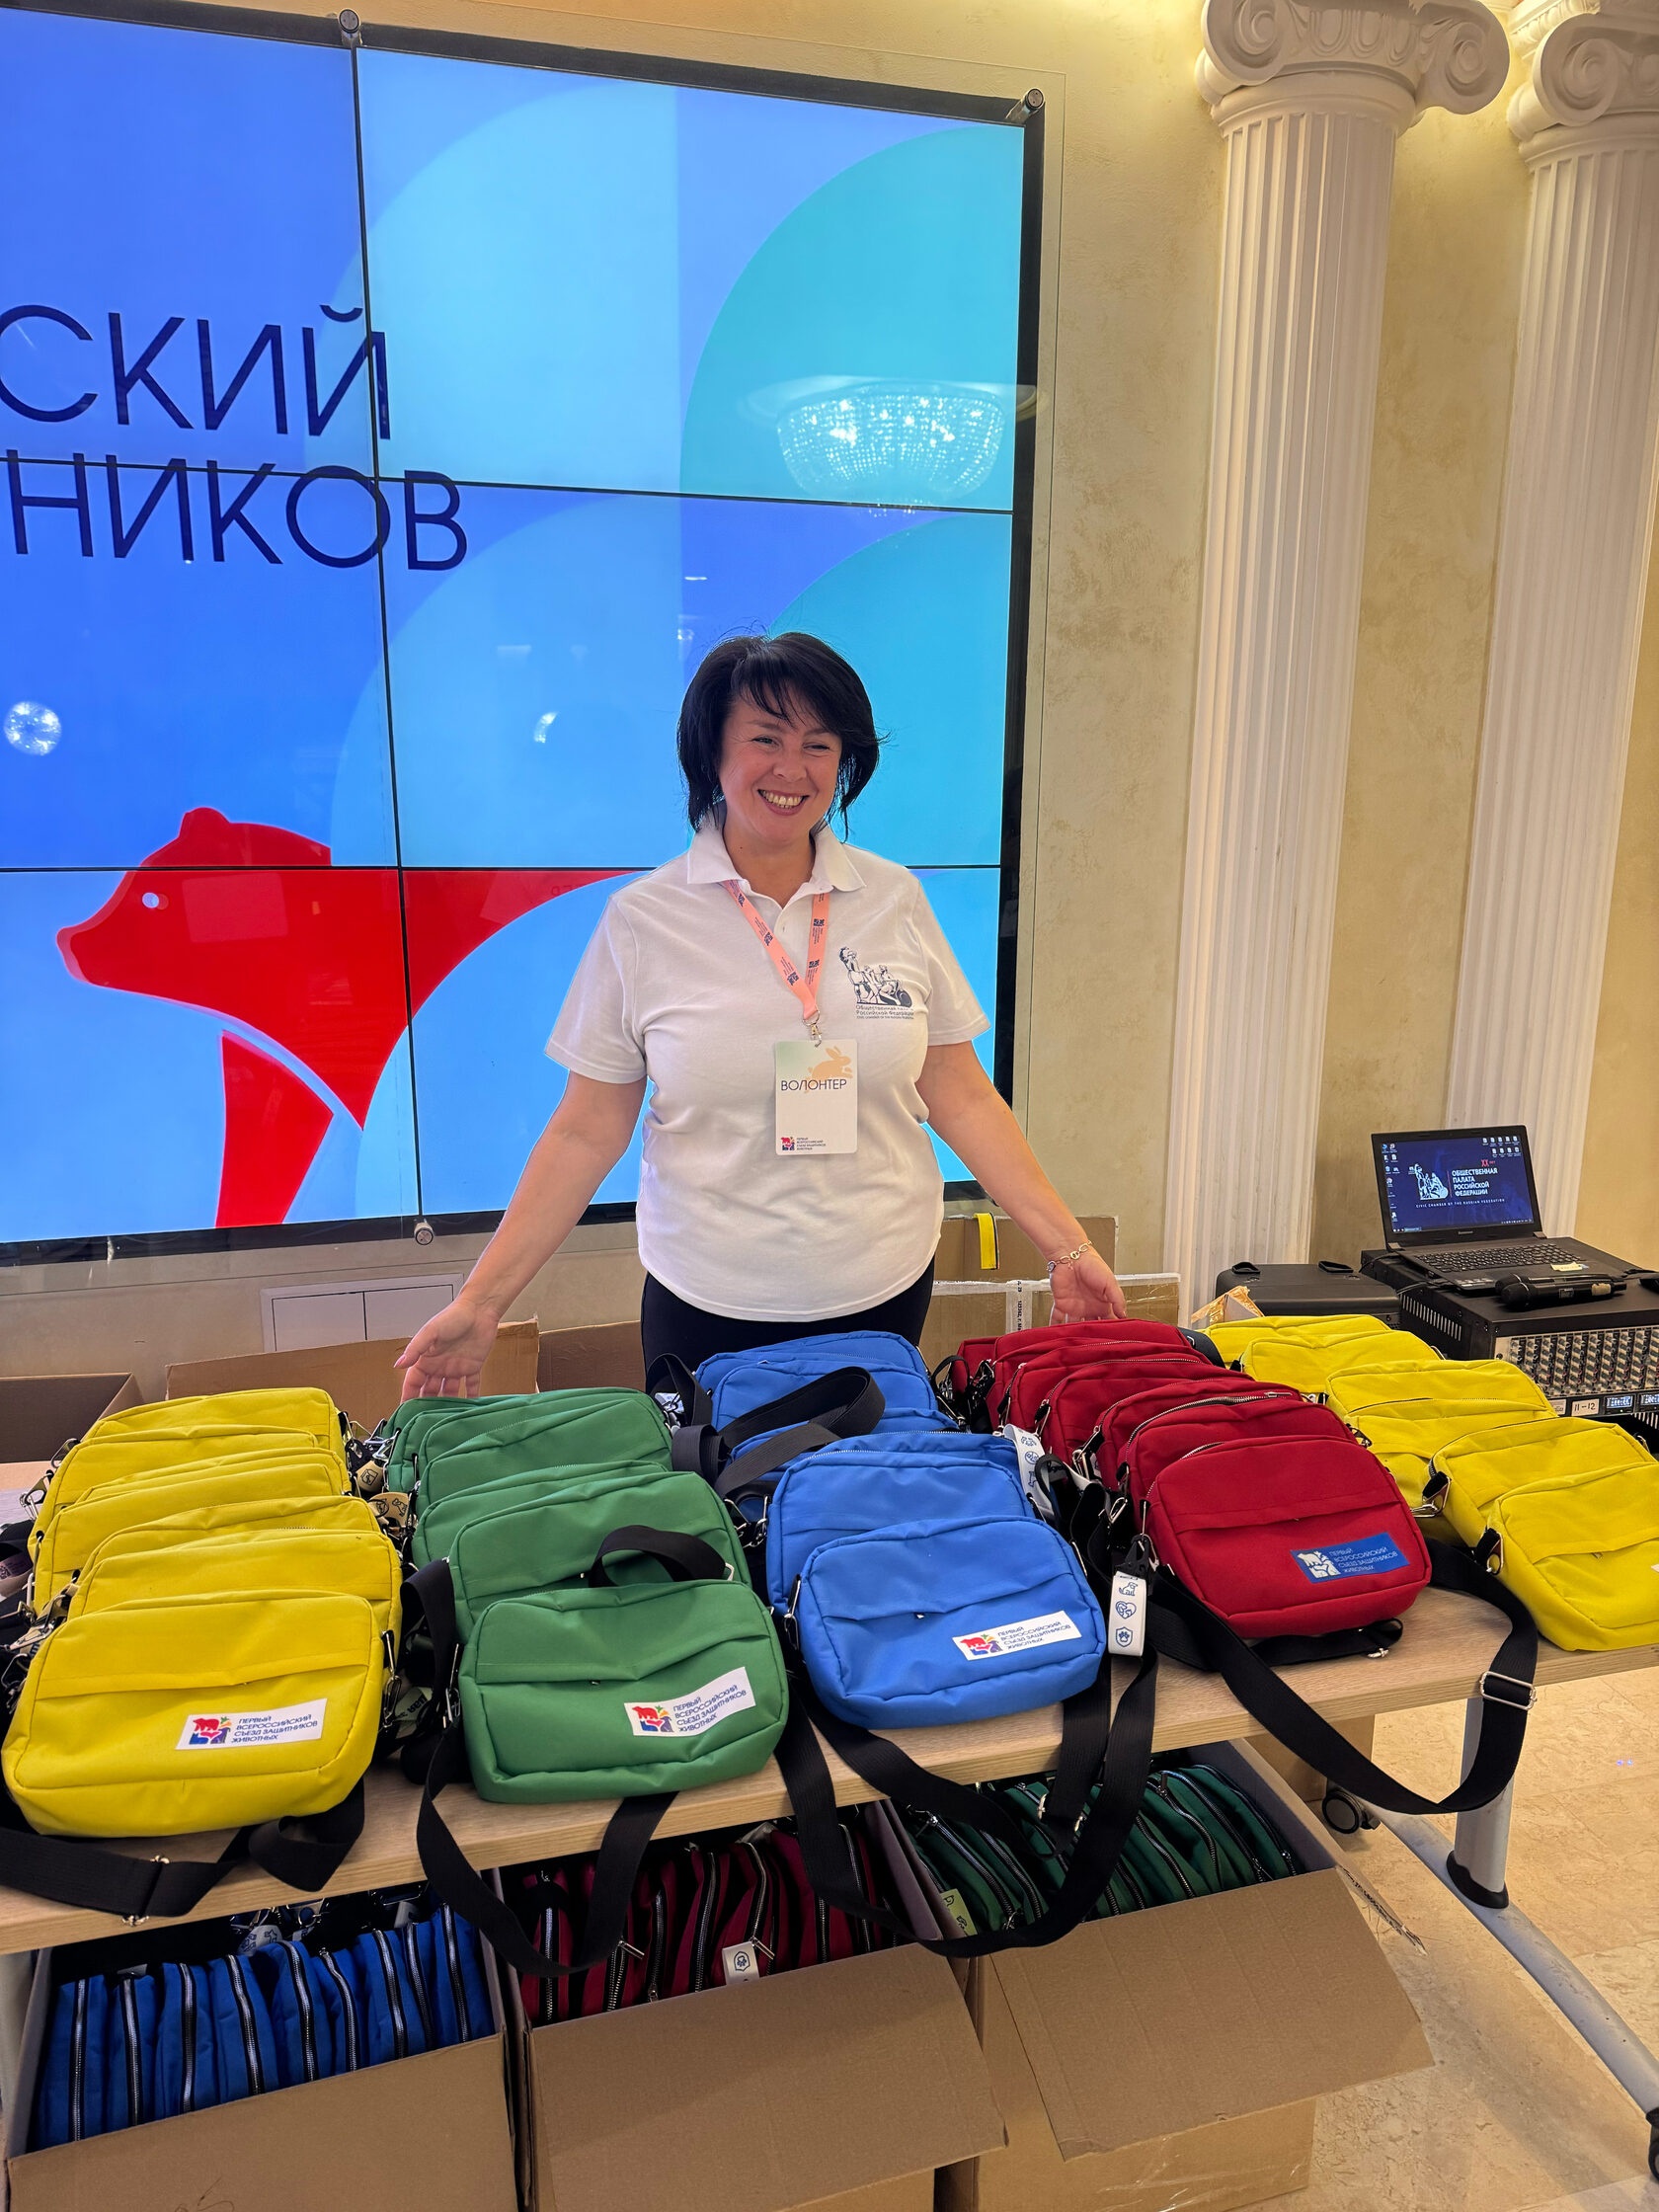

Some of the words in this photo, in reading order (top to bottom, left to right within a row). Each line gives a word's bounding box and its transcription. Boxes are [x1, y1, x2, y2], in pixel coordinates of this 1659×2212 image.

[0, 304, 391, 439] СКИЙ
[7, 449, 467, 571] НИКОВ
[781, 1079, 847, 1091] ВОЛОНТЕР
[1452, 1167, 1498, 1176] ОБЩЕСТВЕННАЯ
[1454, 1181, 1489, 1190] РОССИЙСКОЙ
[997, 1626, 1024, 1636] ПЕРВЫЙ
[1000, 1621, 1062, 1641] ВСЕРОССИЙСКИЙ
[672, 1697, 702, 1711] ПЕРВЫЙ
[674, 1685, 739, 1719] ВСЕРОССИЙСКИЙ
[676, 1714, 701, 1726] СЪЕЗД
[701, 1690, 747, 1719] ЗАЩИТНИКОВ
[236, 1713, 312, 1730] ВСЕРОССИЙСКИЙ
[238, 1715, 272, 1724] ПЕРВЫЙ
[678, 1714, 718, 1732] ЖИВОТНЫХ
[234, 1728, 262, 1737] СЪЕЗД
[263, 1720, 318, 1734] ЗАЩИТНИКОВ
[231, 1734, 279, 1744] ЖИВОТНЫХ
